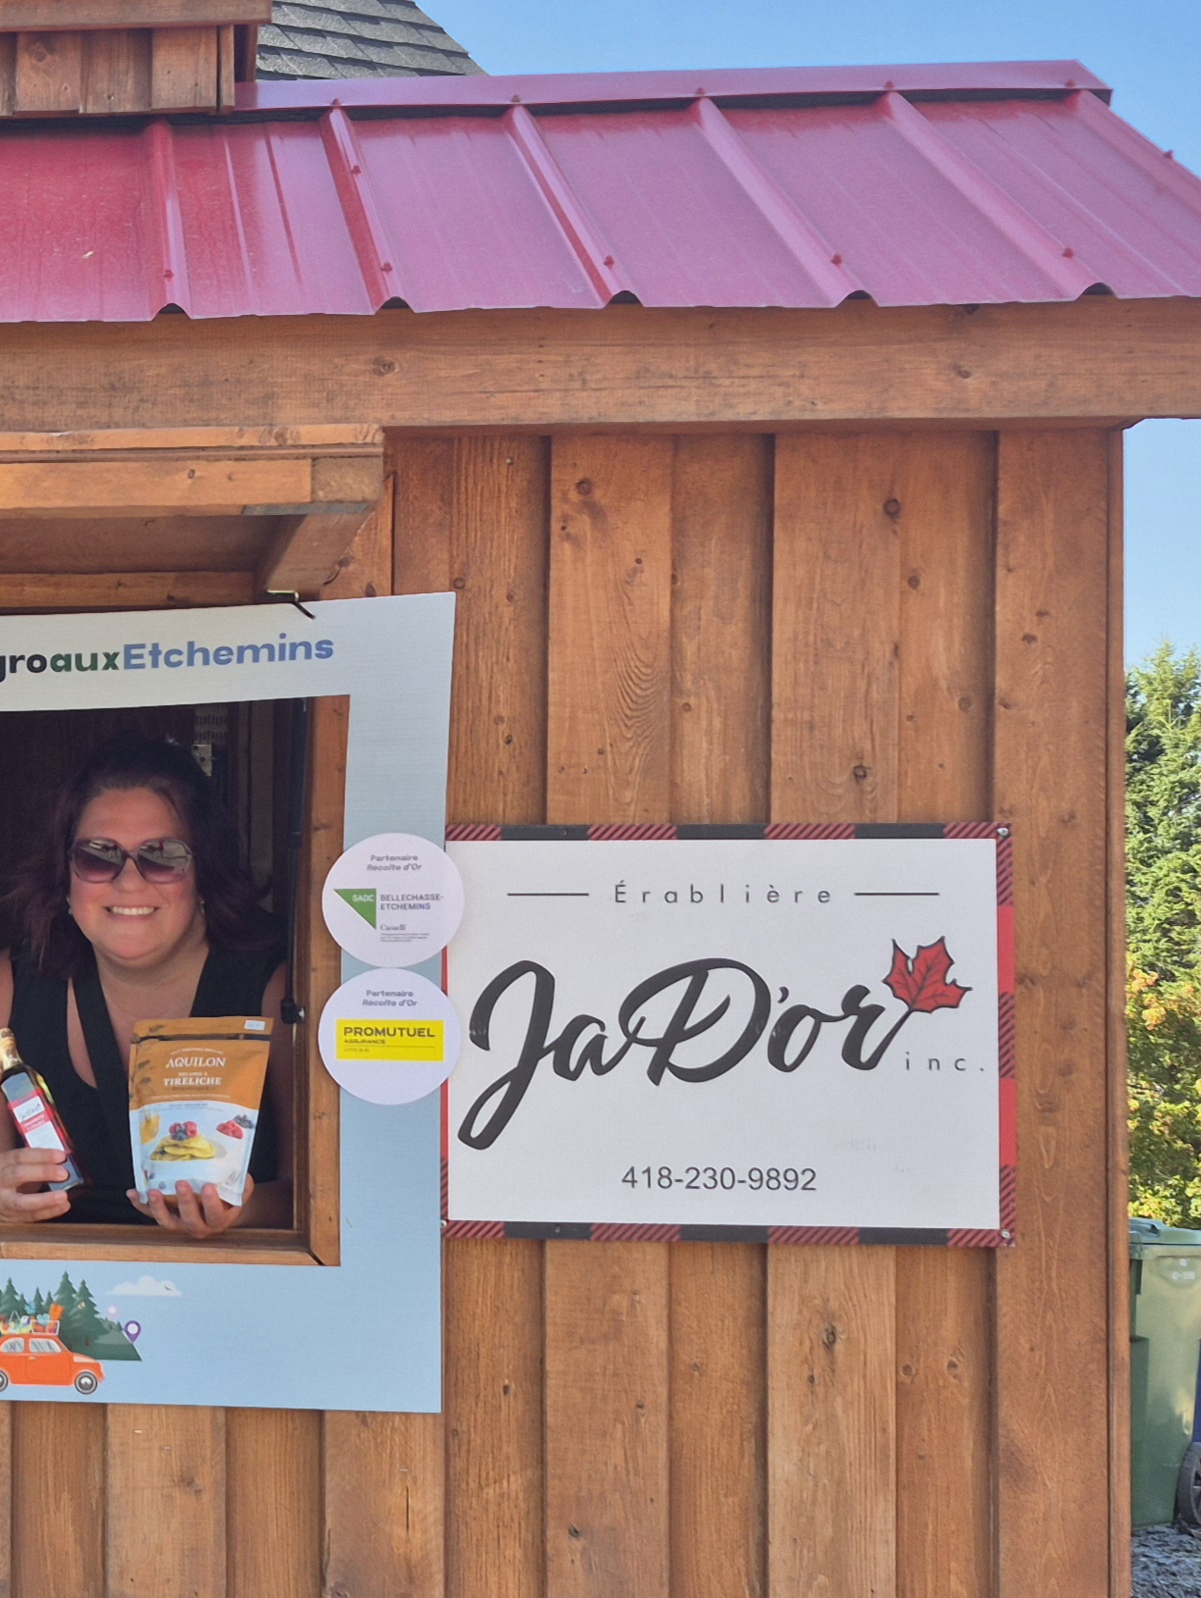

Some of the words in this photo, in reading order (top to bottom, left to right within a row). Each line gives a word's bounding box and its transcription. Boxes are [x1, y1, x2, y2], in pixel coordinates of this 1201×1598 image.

[403, 863, 422, 871] d'Or
[352, 894, 374, 902] SADC
[615, 880, 832, 904] Érablière
[366, 990, 414, 998] Partenaire
[362, 999, 396, 1007] Récolte
[344, 1026, 436, 1038] PROMUTUEL
[458, 957, 911, 1150] JaD'or
[166, 1057, 226, 1069] AQUILON
[905, 1053, 985, 1072] inc.
[622, 1166, 817, 1192] 418-230-9892
